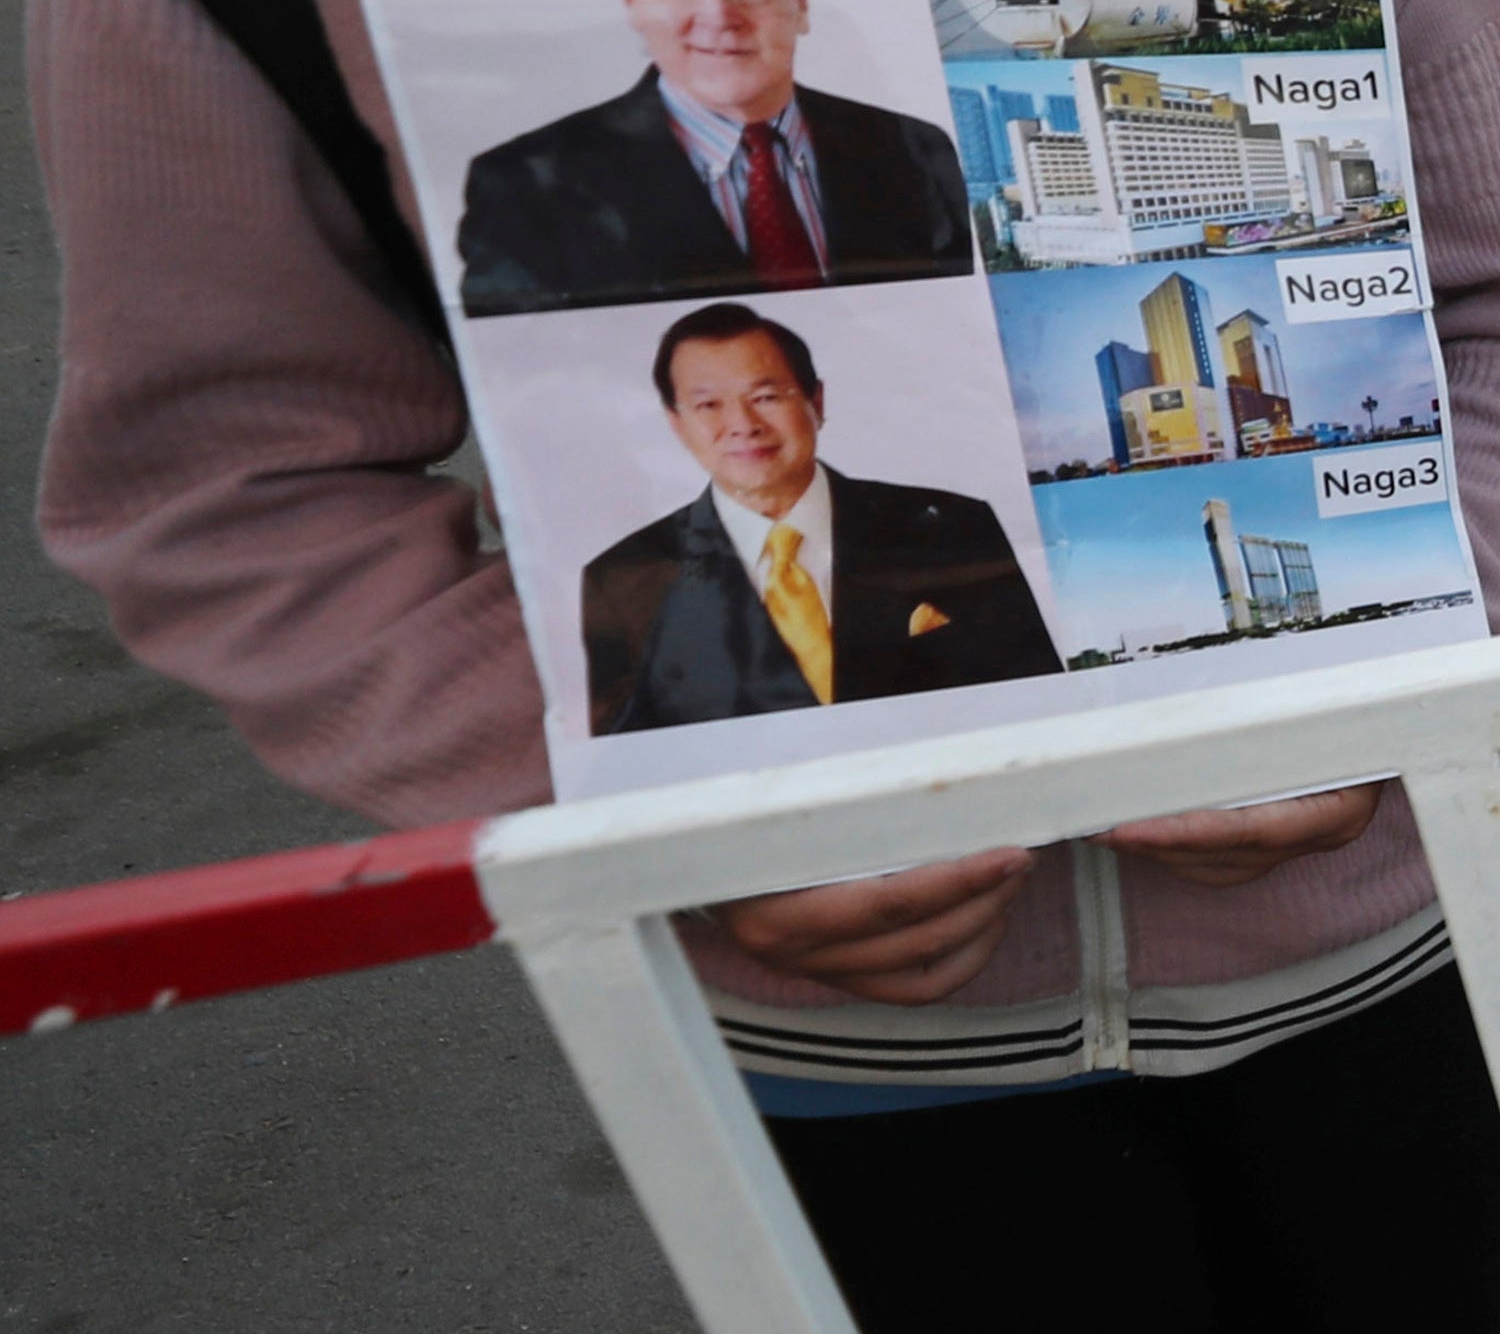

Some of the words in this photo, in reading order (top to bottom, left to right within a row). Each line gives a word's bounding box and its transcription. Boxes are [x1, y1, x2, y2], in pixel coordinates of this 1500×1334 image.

[1253, 69, 1379, 112] Naga1
[1285, 266, 1413, 308] Naga2
[1322, 457, 1440, 499] Naga3
